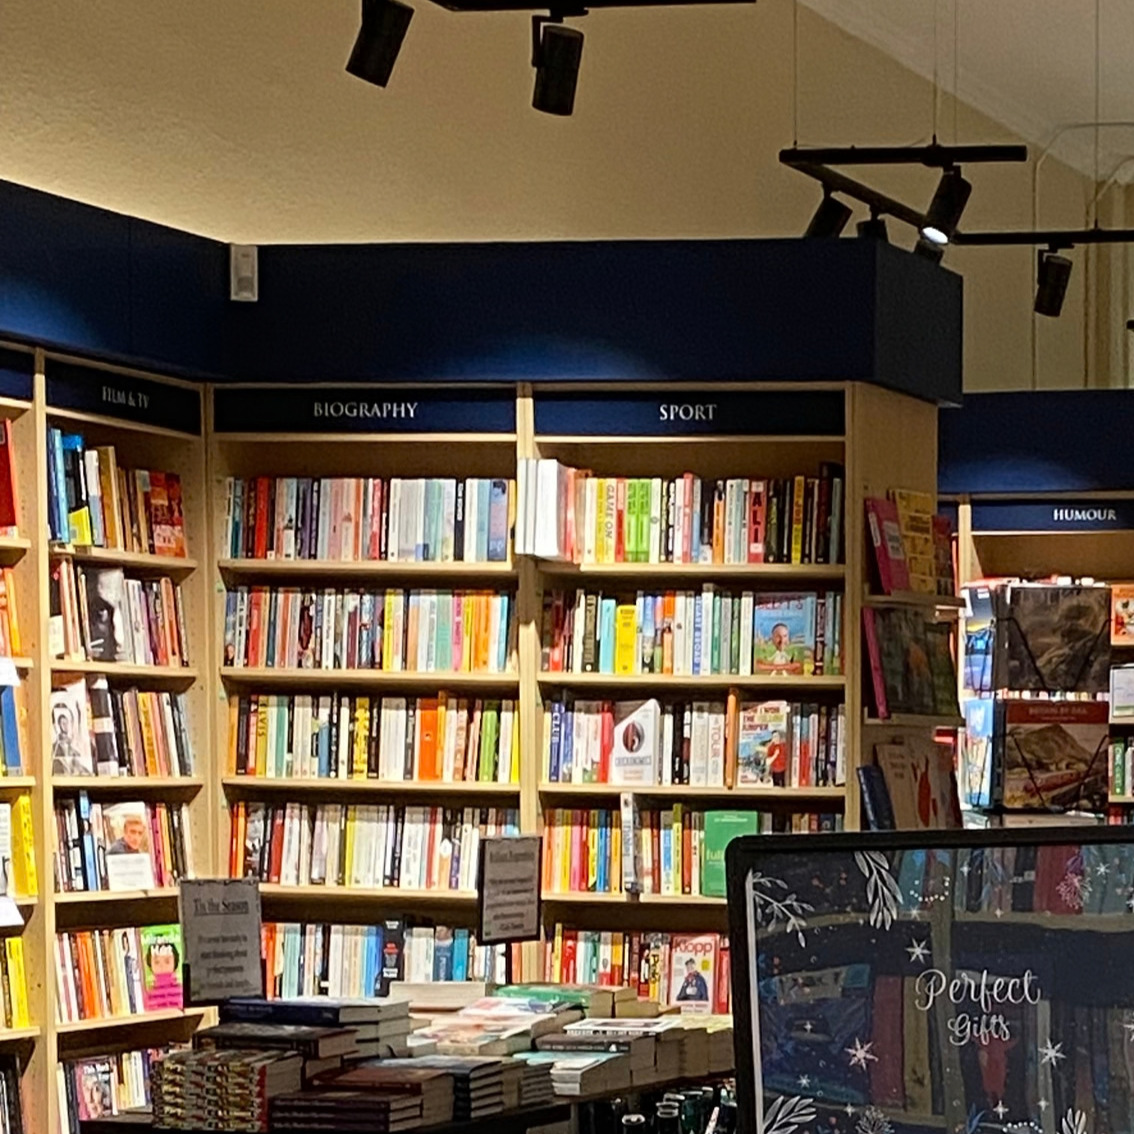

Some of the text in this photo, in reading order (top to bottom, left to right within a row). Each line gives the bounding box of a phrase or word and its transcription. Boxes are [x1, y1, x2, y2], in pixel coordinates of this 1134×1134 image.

[101, 386, 126, 404] FILM
[137, 393, 150, 409] TV
[313, 401, 418, 419] BIOGRAPHY
[659, 403, 718, 421] SPORT
[751, 490, 763, 544] ALI
[1053, 508, 1116, 521] HUMOUR
[915, 968, 1042, 1011] Perfect
[947, 1012, 1012, 1046] Gifts
